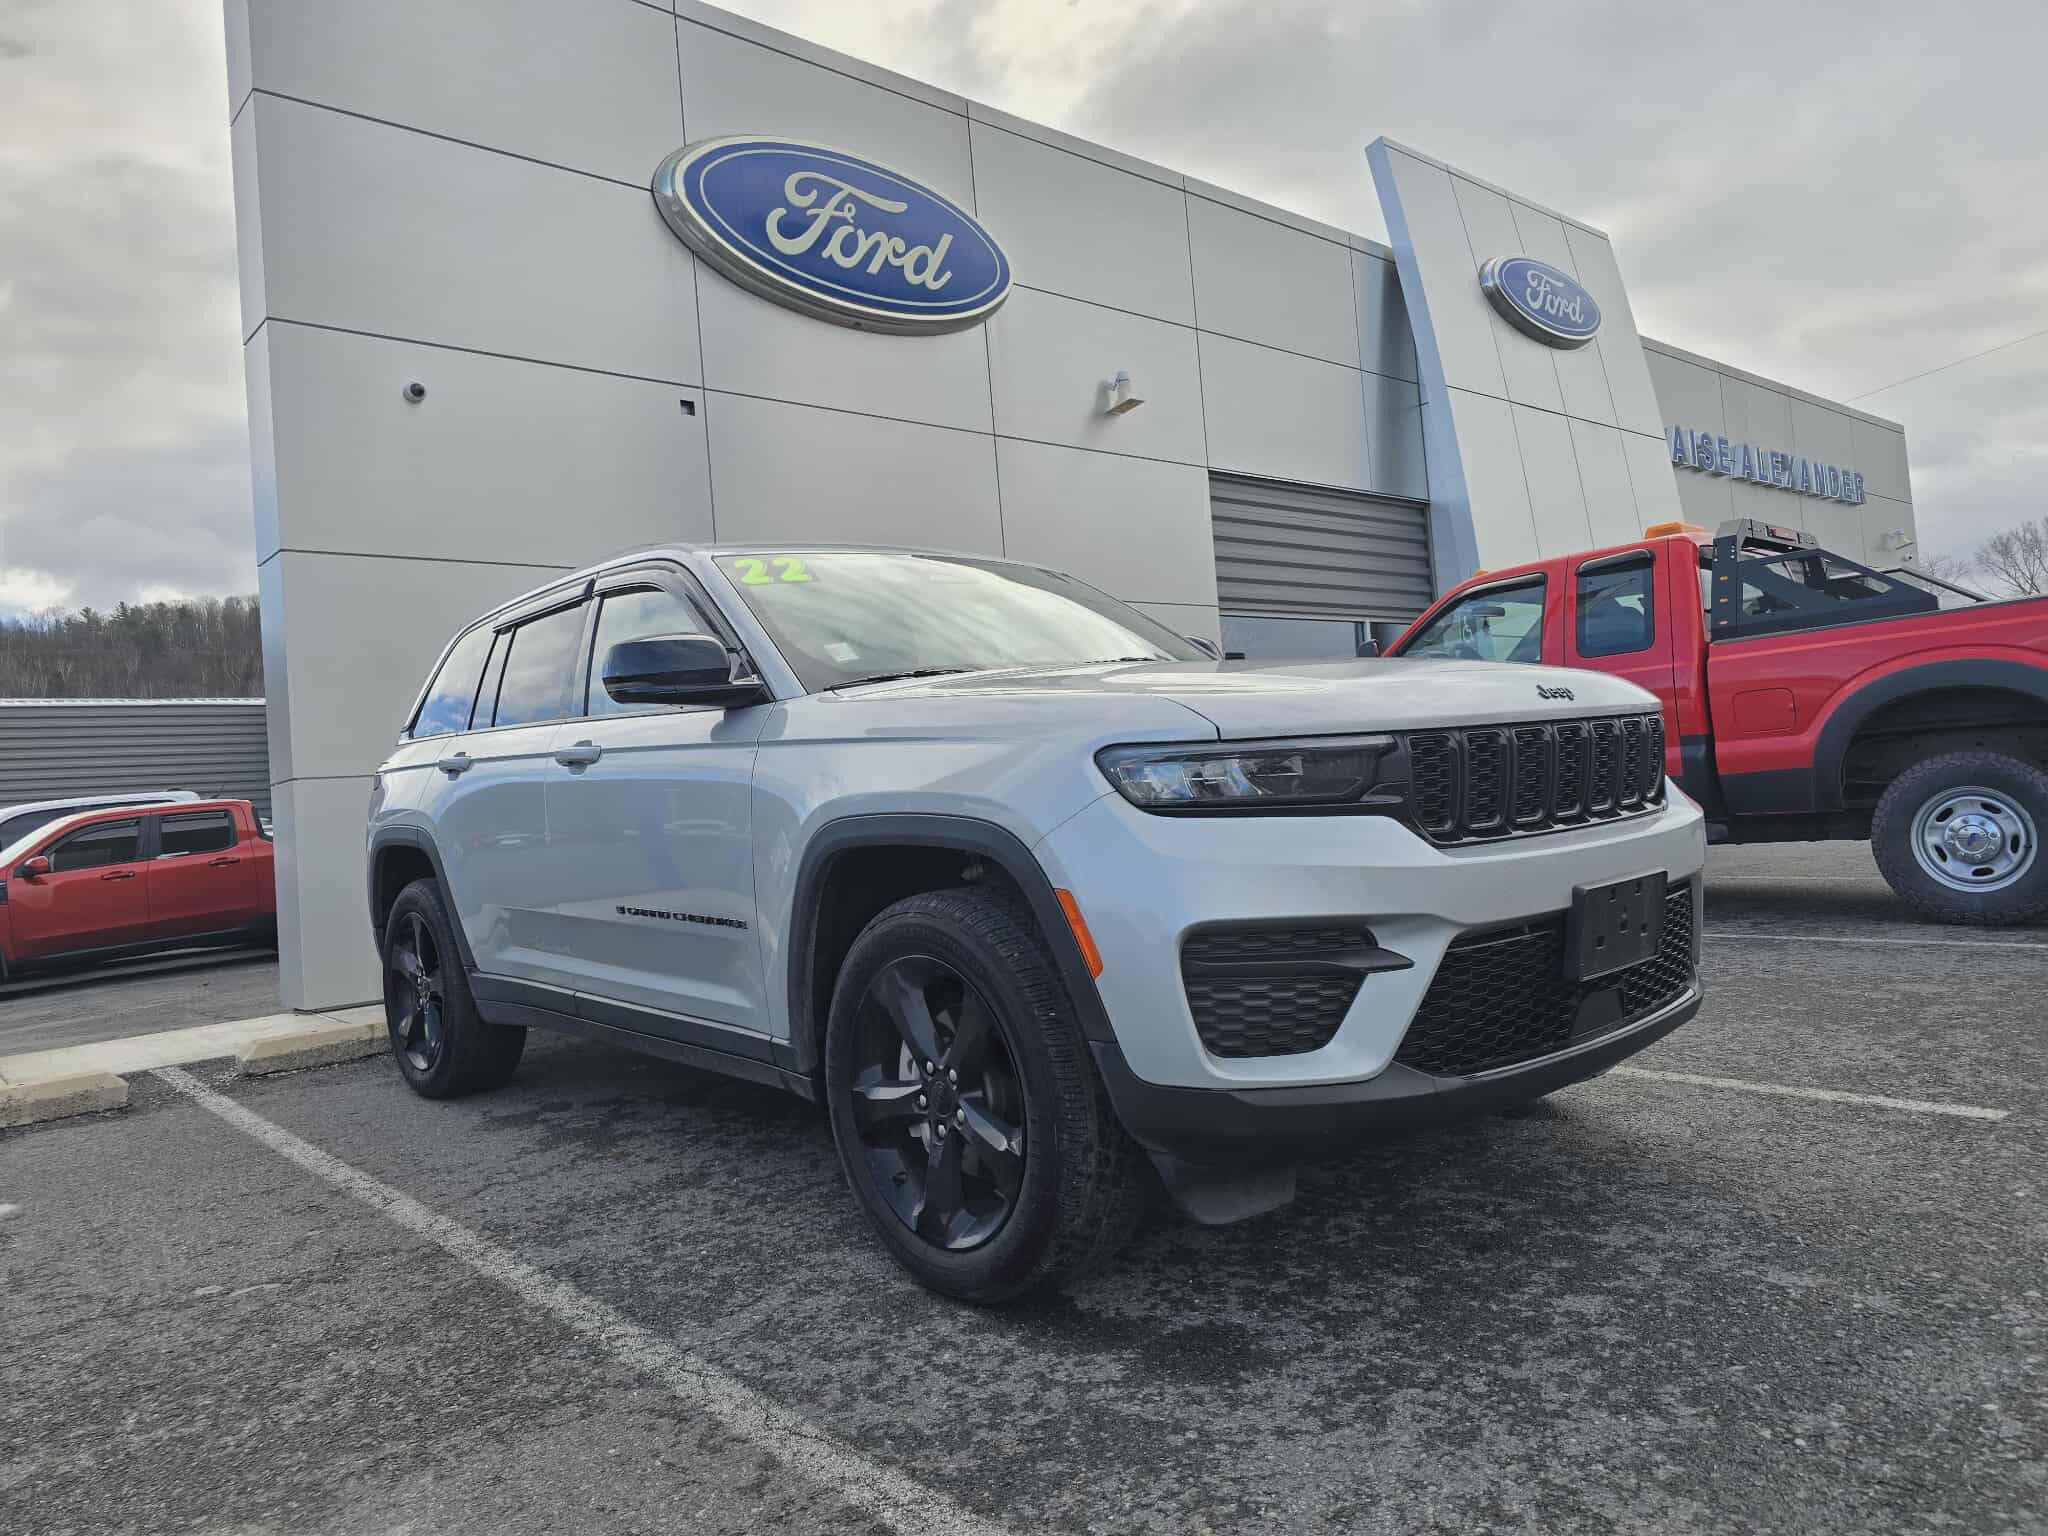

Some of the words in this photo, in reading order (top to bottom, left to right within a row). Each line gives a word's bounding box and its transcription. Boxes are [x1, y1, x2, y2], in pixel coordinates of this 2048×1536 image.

[766, 171, 953, 290] Ford
[1526, 270, 1584, 323] Ford
[1736, 443, 1864, 502] ALEXANDER
[735, 557, 813, 585] 22
[1536, 684, 1575, 701] Jeep
